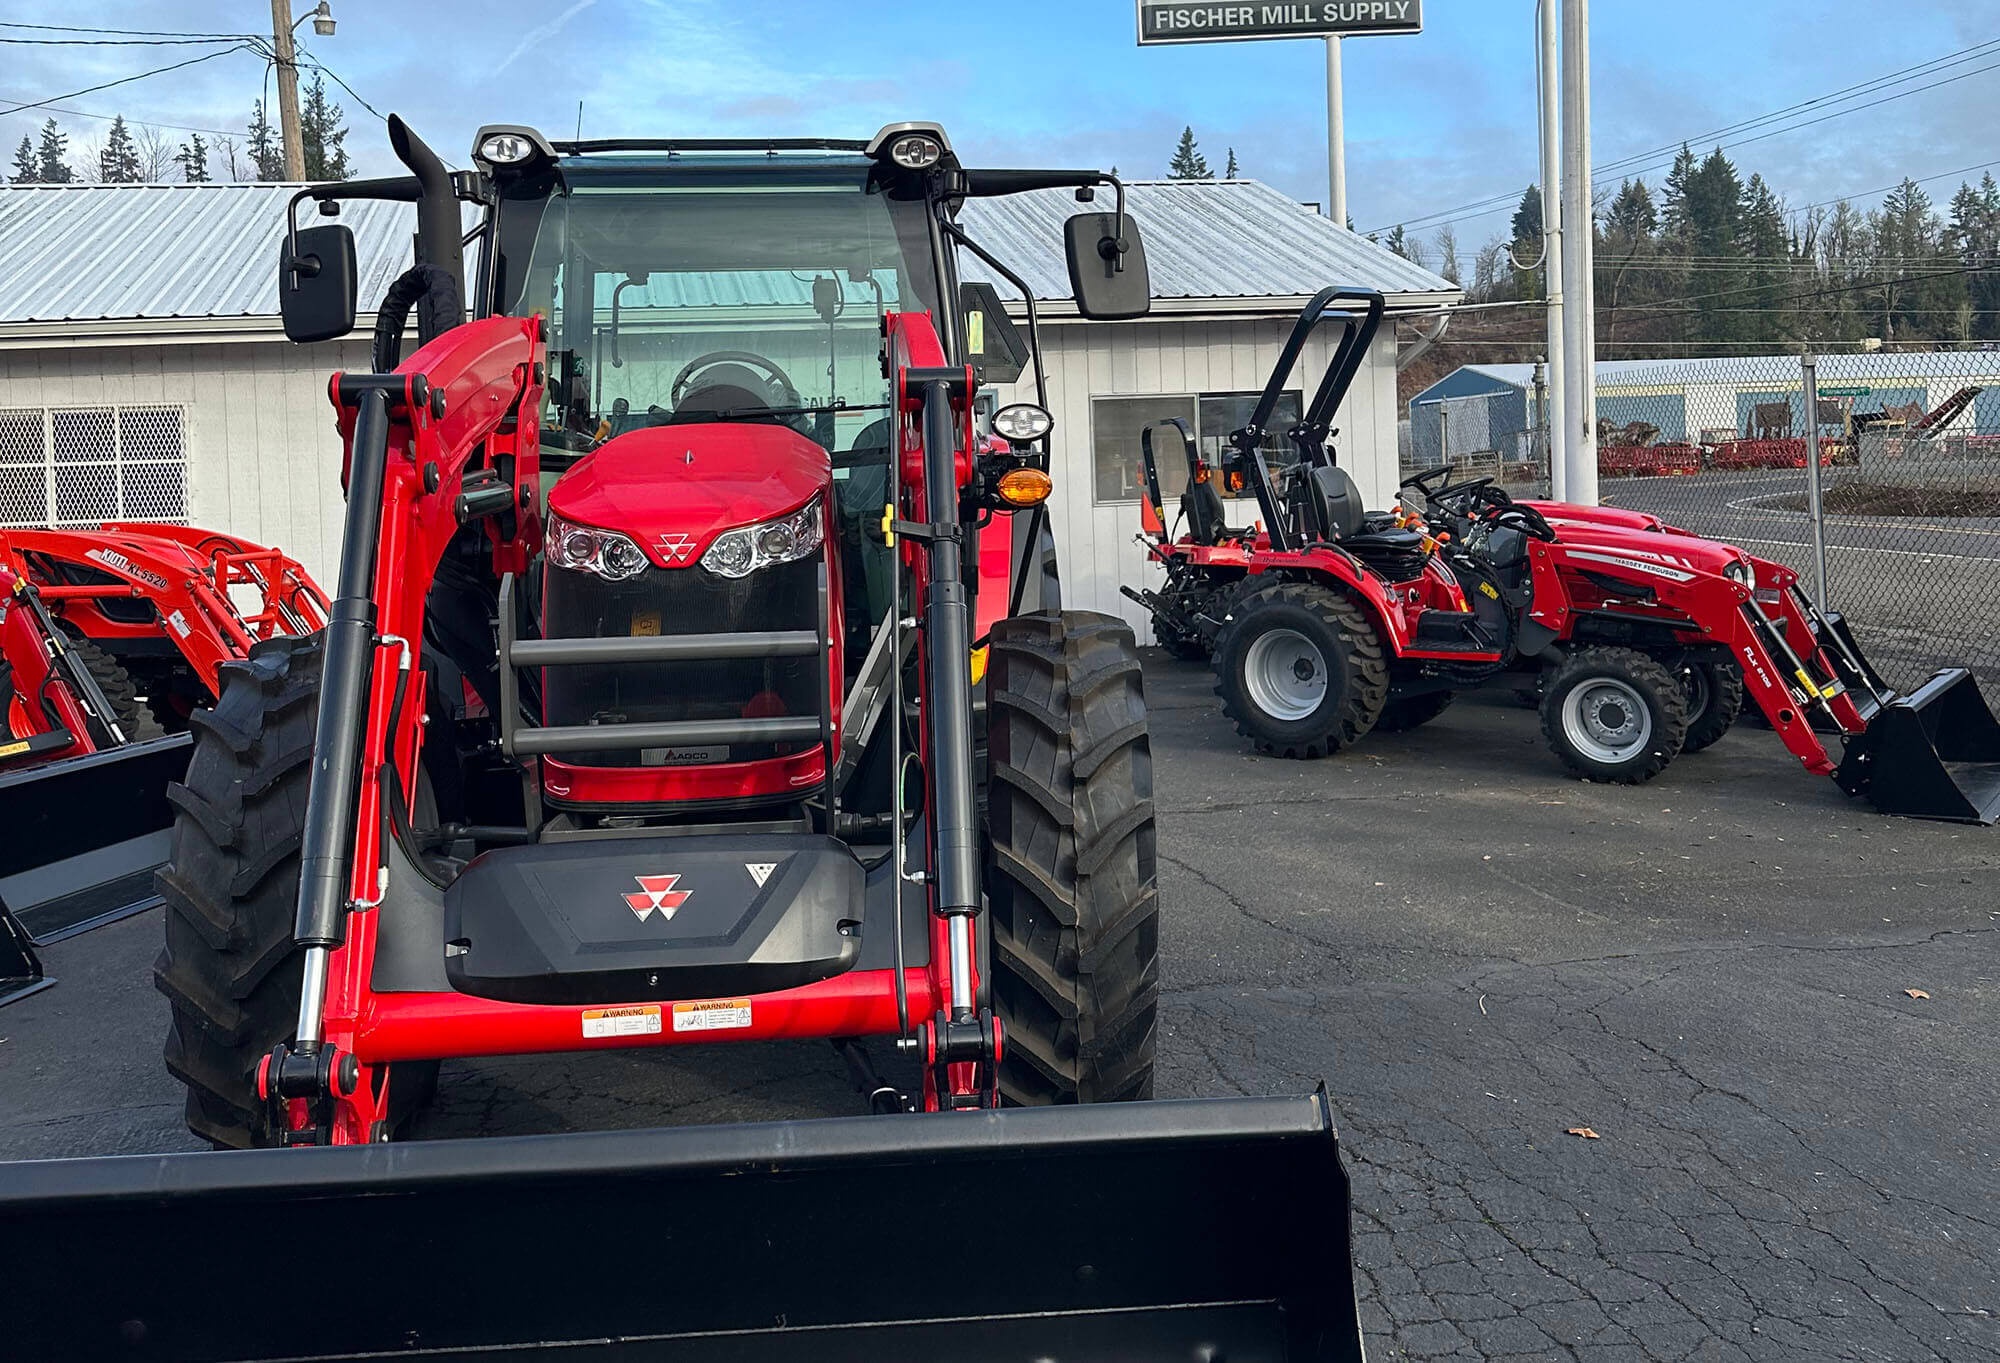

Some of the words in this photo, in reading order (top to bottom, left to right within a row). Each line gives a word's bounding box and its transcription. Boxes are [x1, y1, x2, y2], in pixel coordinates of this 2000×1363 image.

[1155, 7, 1254, 29] FISCHER
[1262, 5, 1317, 25] MILL
[1323, 1, 1410, 21] SUPPLY
[101, 548, 128, 569] KIOTI
[1643, 564, 1679, 577] FERGUSON
[1743, 646, 1758, 667] FLX
[609, 1008, 644, 1017] WARNING
[700, 1001, 734, 1010] WARNING
